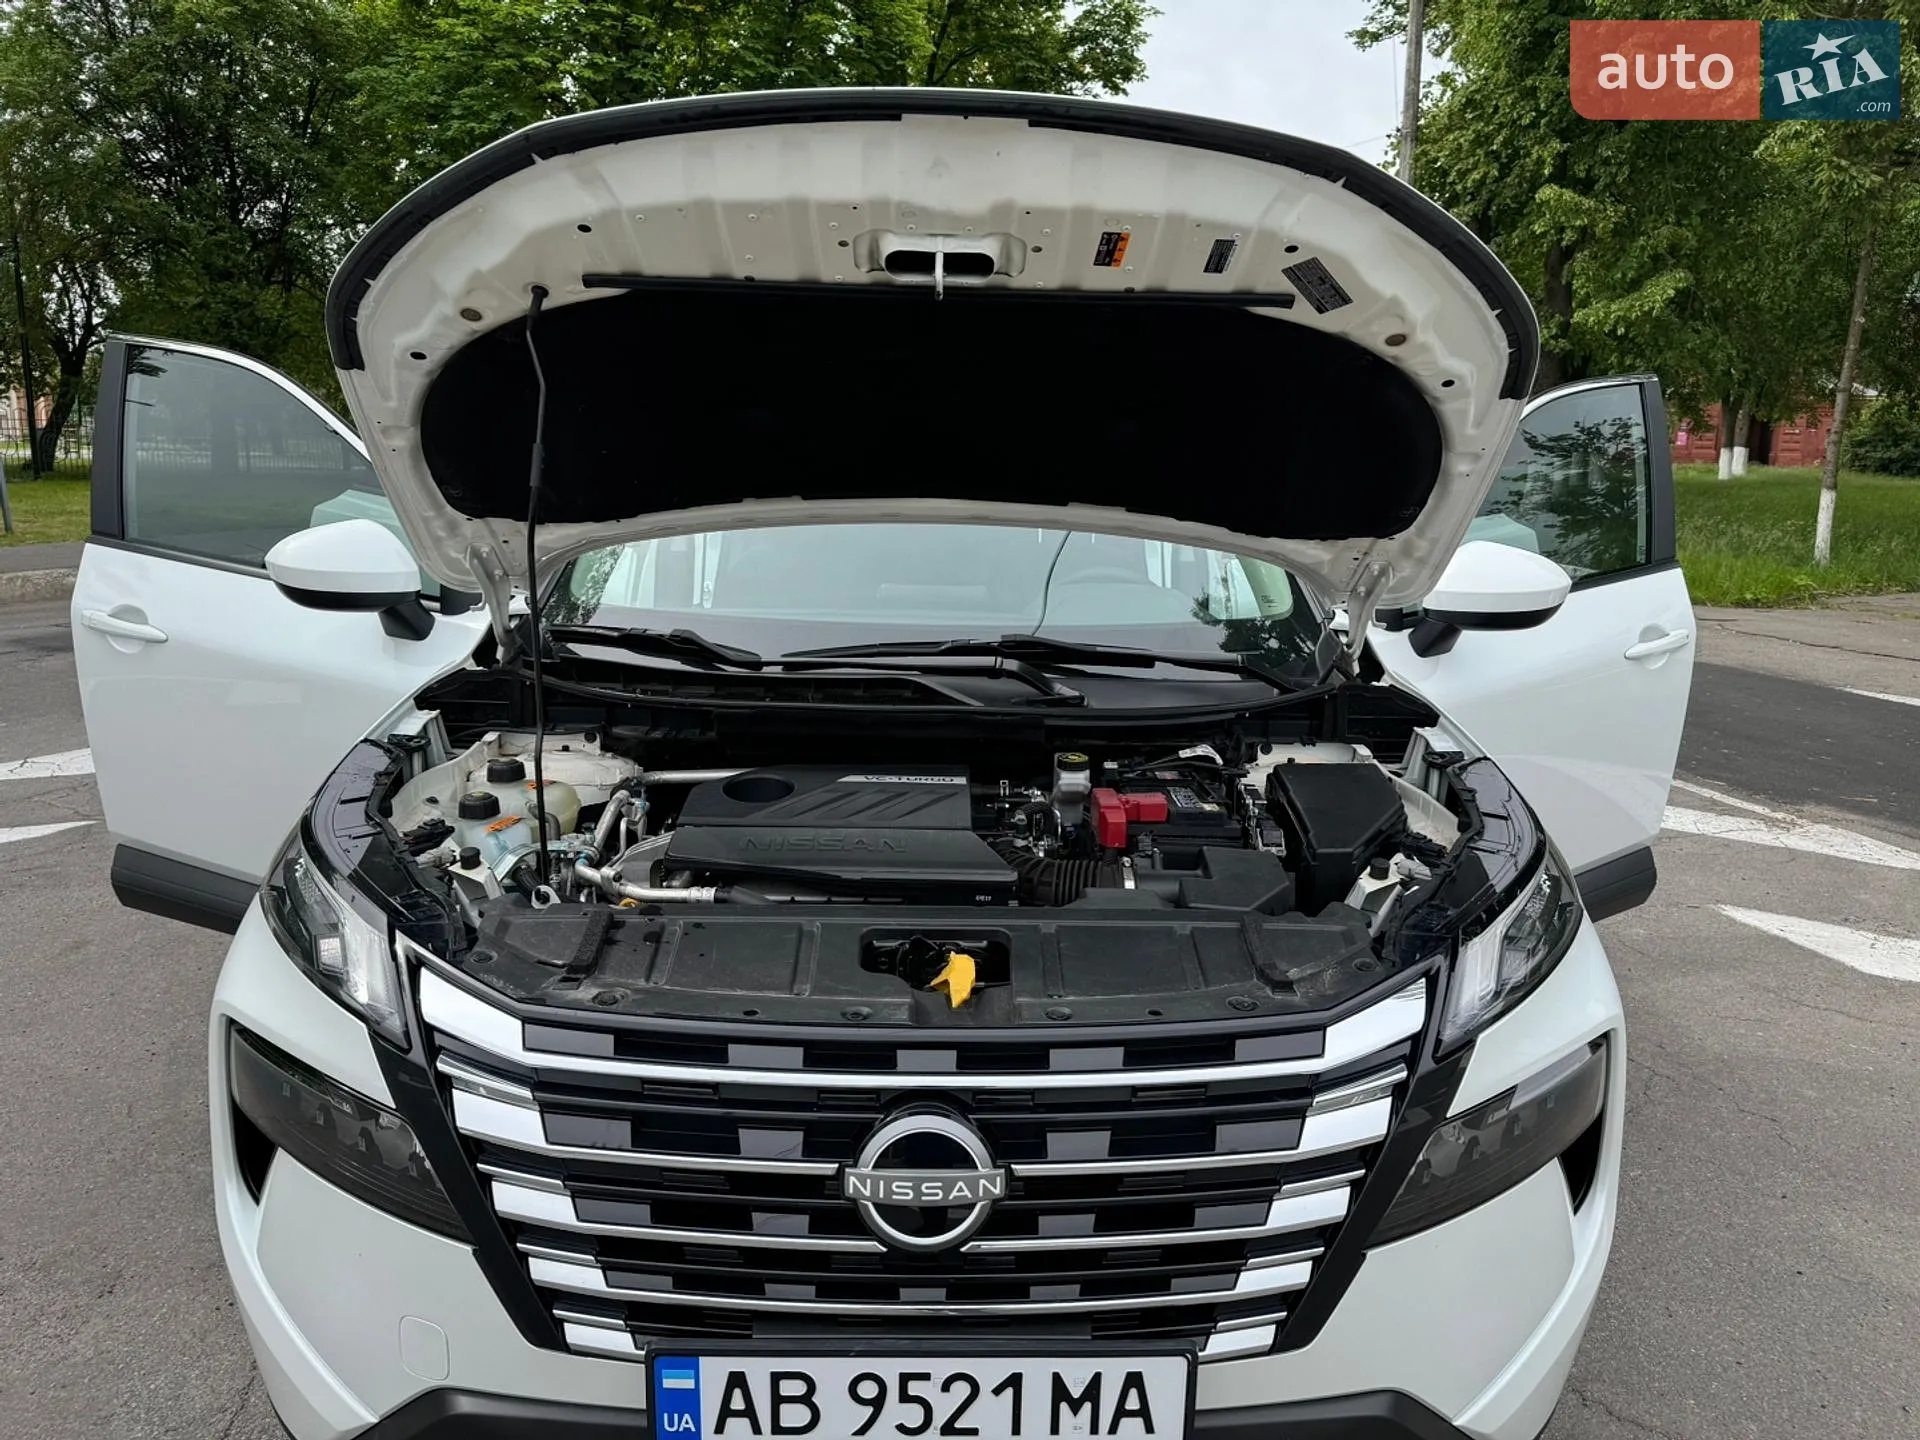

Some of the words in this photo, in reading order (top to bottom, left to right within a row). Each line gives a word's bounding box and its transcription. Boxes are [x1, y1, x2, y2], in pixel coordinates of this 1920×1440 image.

[741, 833, 908, 853] NISSAN
[849, 1175, 1001, 1201] NISSAN
[713, 1370, 822, 1436] AB
[847, 1370, 1024, 1437] 9521
[1049, 1370, 1156, 1436] MA
[662, 1411, 697, 1433] UA
